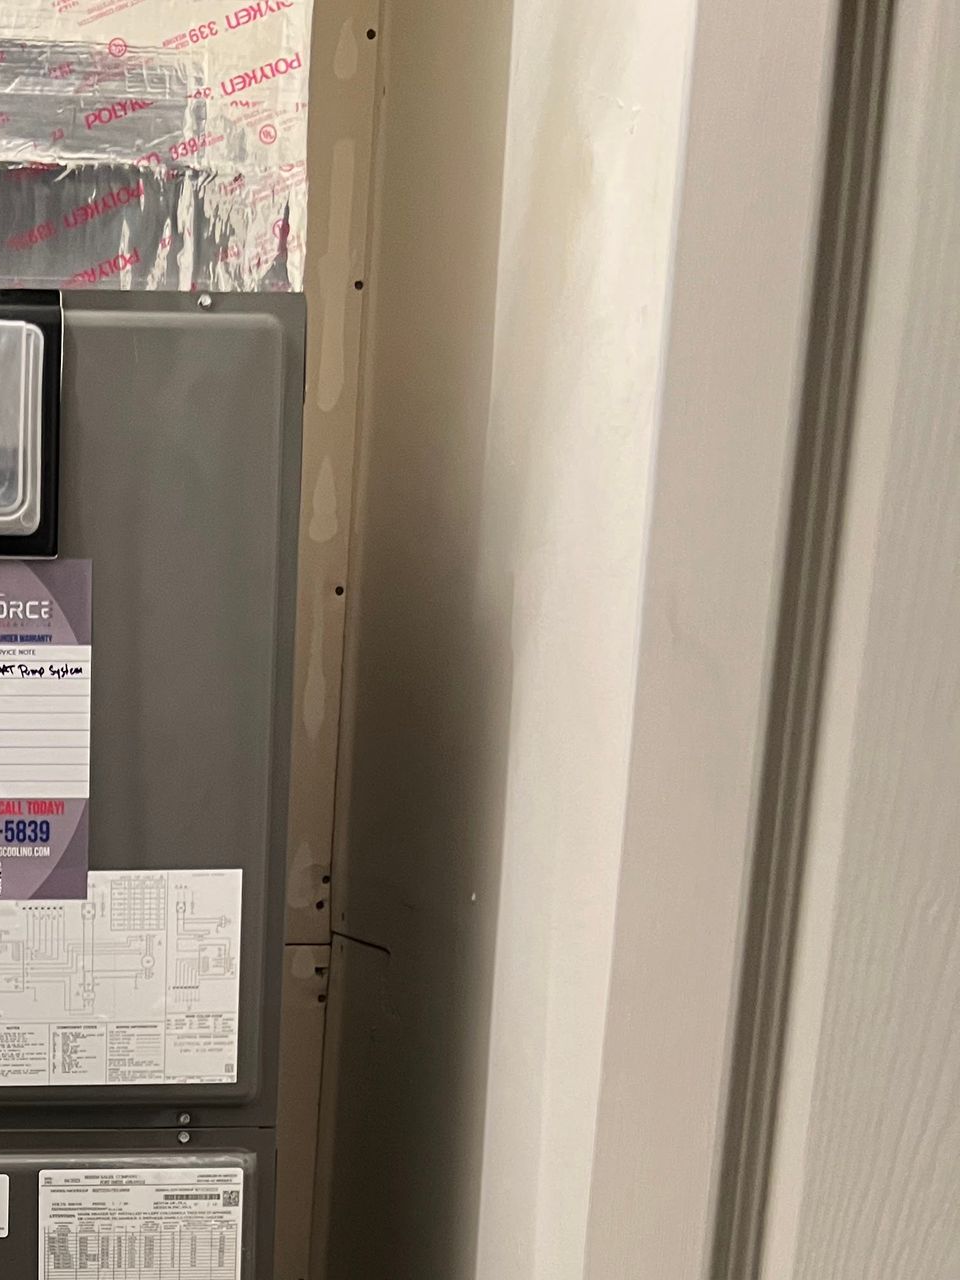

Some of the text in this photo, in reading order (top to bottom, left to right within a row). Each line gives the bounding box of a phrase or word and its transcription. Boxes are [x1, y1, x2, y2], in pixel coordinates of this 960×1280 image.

[189, 21, 218, 44] 339
[221, 53, 302, 96] POLYKEN
[19, 635, 52, 643] WARRANTY
[27, 801, 65, 815] TODAY!
